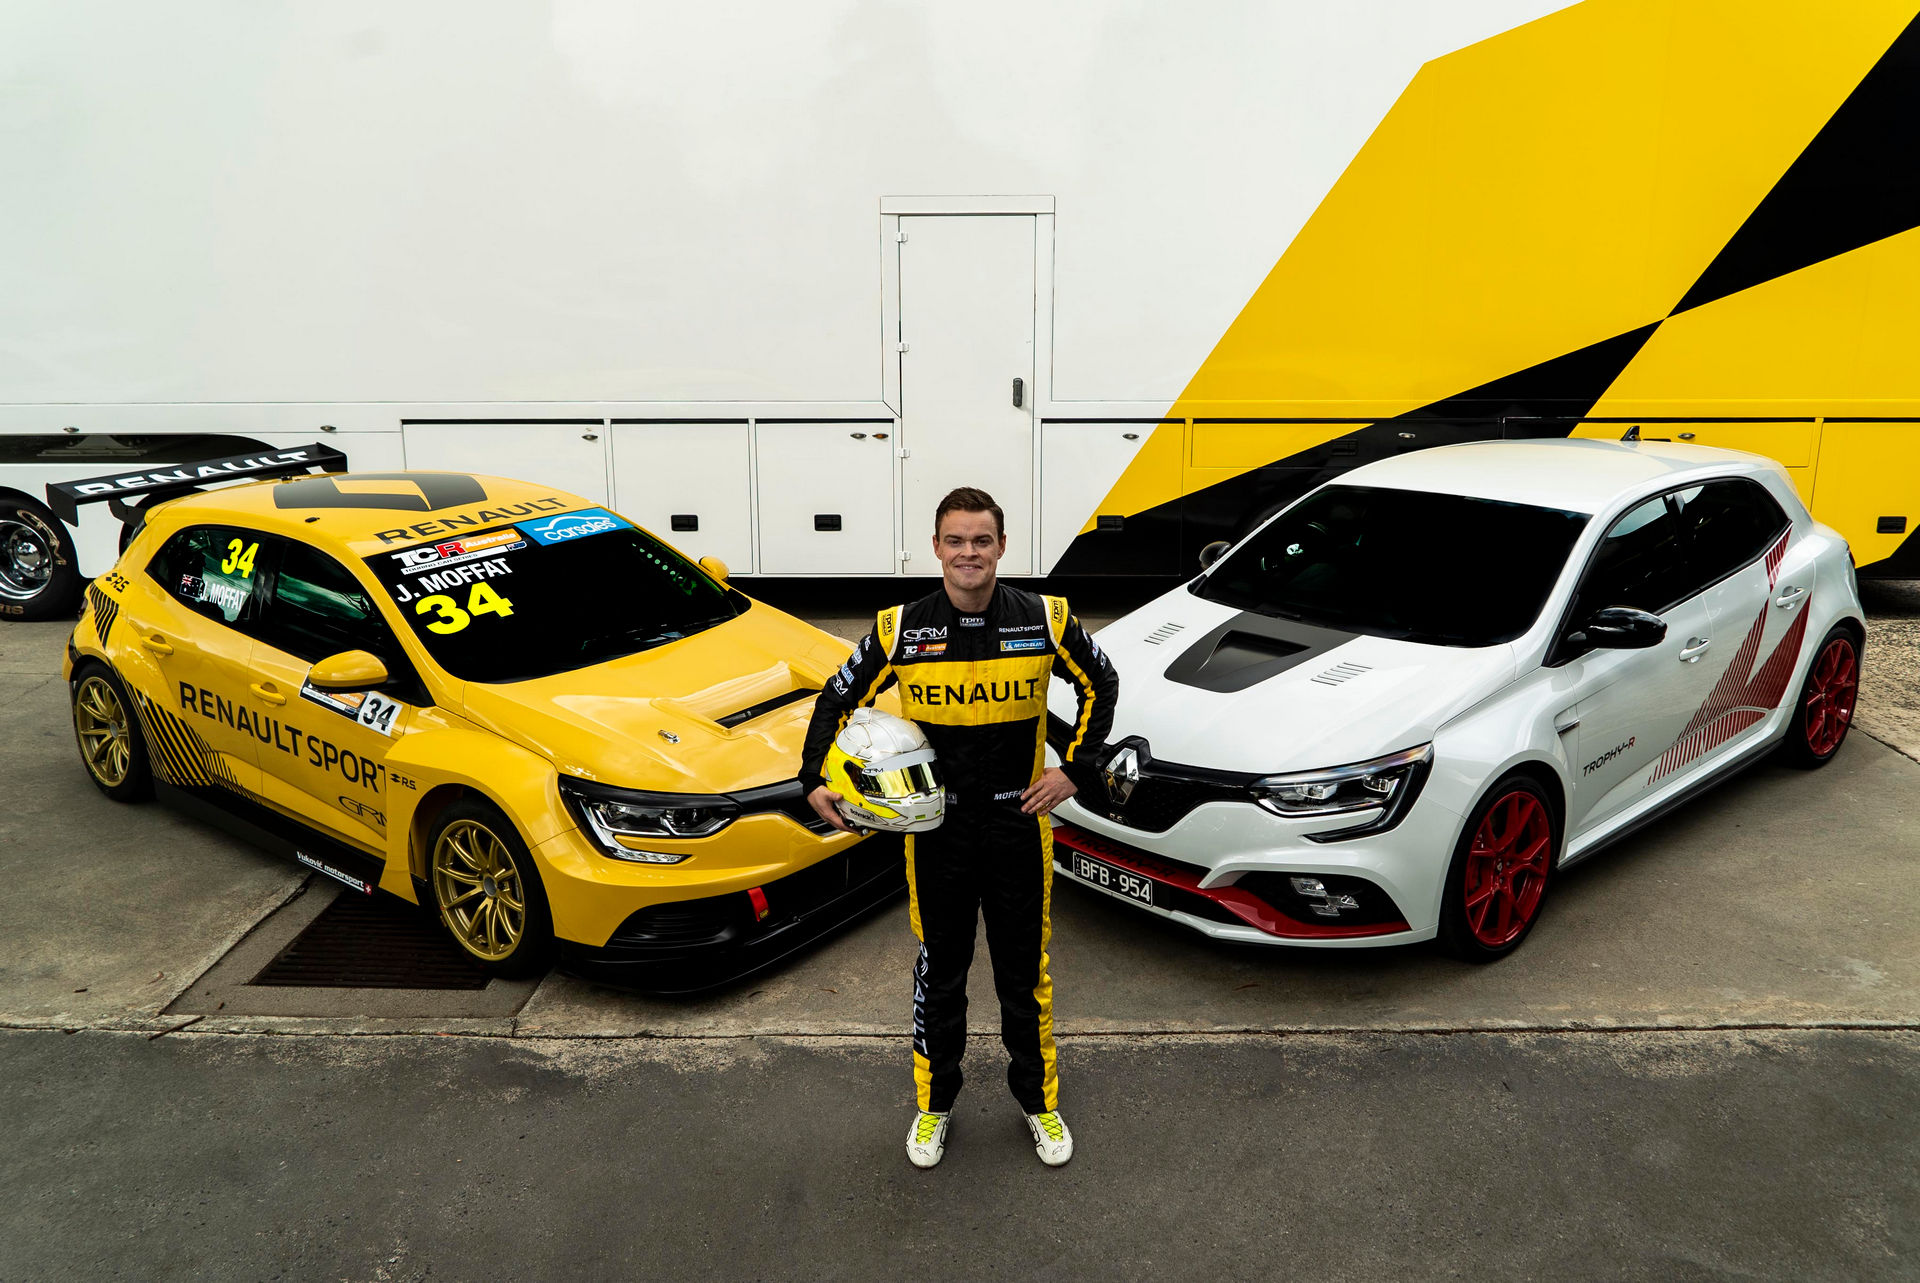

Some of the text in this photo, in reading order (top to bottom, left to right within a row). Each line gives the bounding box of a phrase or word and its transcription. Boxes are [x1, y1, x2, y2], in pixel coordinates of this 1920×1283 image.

[74, 451, 308, 496] RENAULT
[374, 498, 568, 545] RENAULT
[544, 519, 617, 541] carsales
[221, 538, 259, 579] 34
[391, 532, 516, 568] TCR Australia
[396, 557, 513, 602] J. MOFFAT
[209, 583, 247, 611] MOFFAT
[415, 581, 515, 635] 34
[903, 625, 948, 640] GRM
[961, 617, 983, 625] rpm
[1024, 624, 1044, 632] SPORT
[1013, 641, 1043, 649] MICHELIN
[908, 678, 1039, 706] RENAULT
[179, 681, 303, 757] RENAULT
[363, 698, 396, 731] 34
[1583, 736, 1636, 777] TROPHY-R
[324, 864, 364, 888] motorsport
